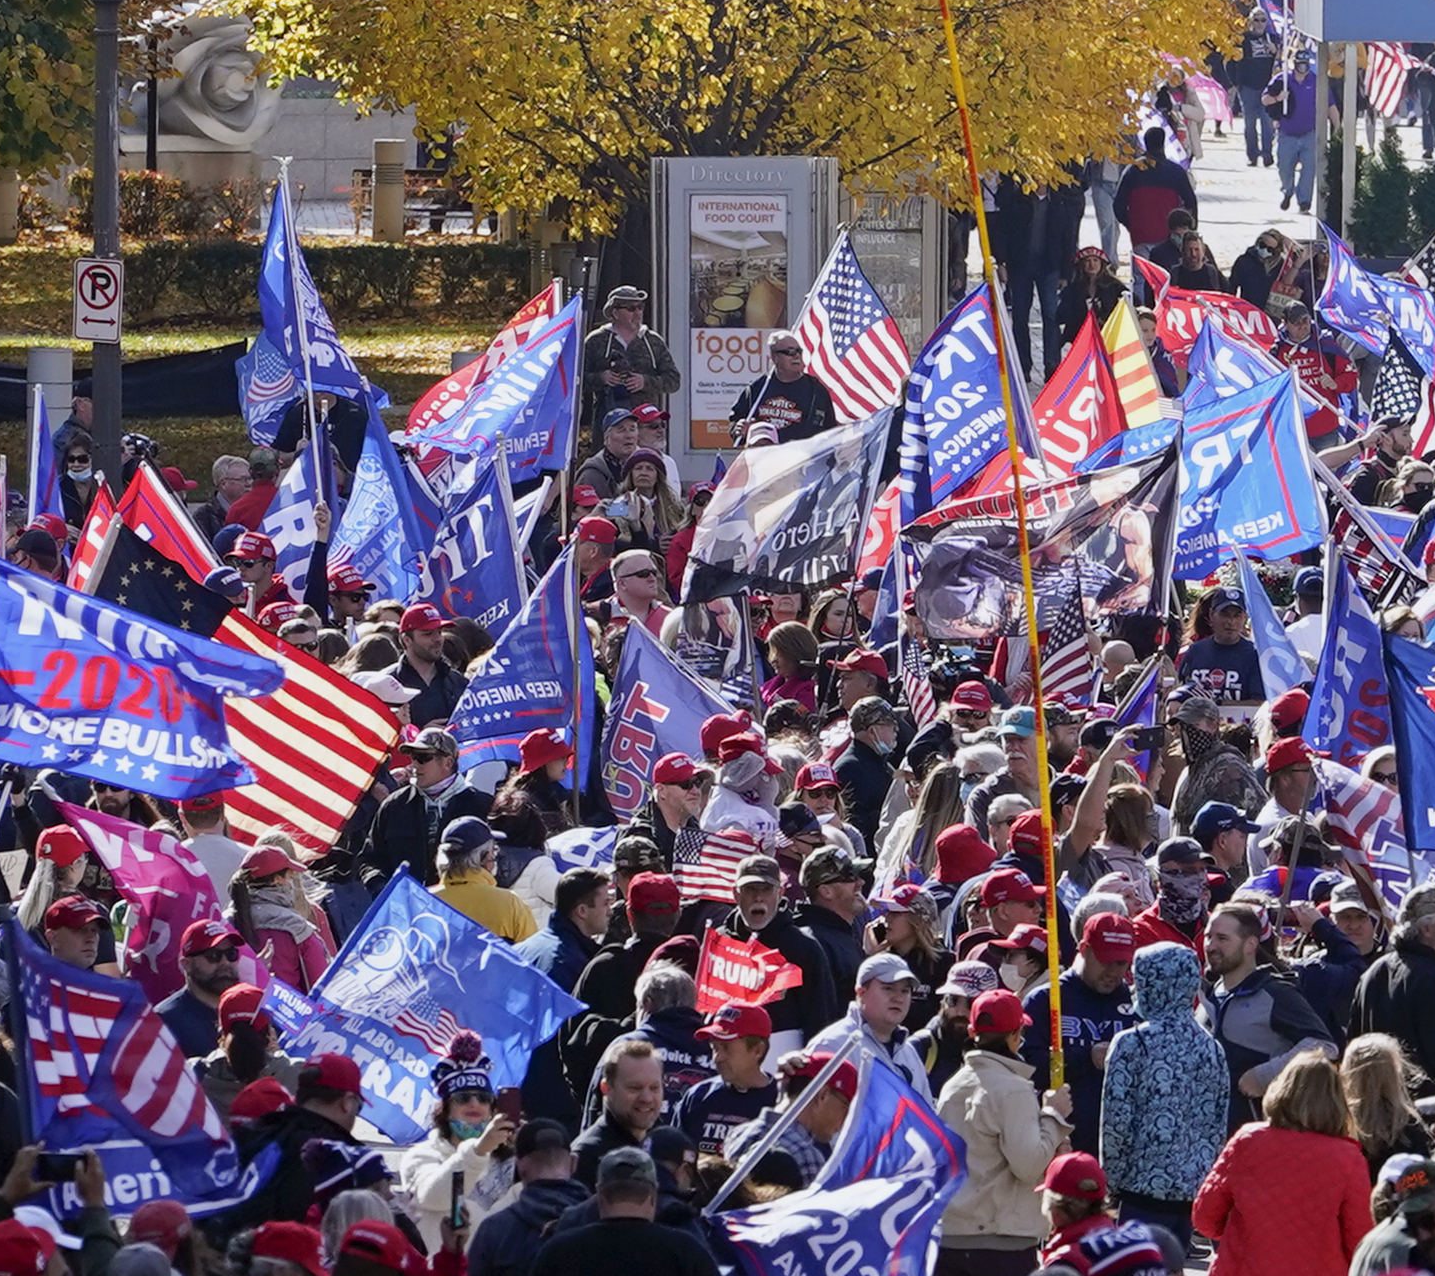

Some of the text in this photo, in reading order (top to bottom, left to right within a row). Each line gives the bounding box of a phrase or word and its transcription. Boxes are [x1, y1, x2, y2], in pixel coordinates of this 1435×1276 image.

[690, 165, 788, 187] Directory
[698, 201, 782, 212] INTERNATIONAL
[704, 213, 775, 224] FOOD COURT
[695, 330, 763, 355] food
[36, 650, 184, 724] 2020
[271, 984, 314, 1019] TRUMP
[360, 1021, 430, 1080] ABOARD
[351, 1041, 435, 1128] TRAI
[447, 1074, 487, 1091] 2020
